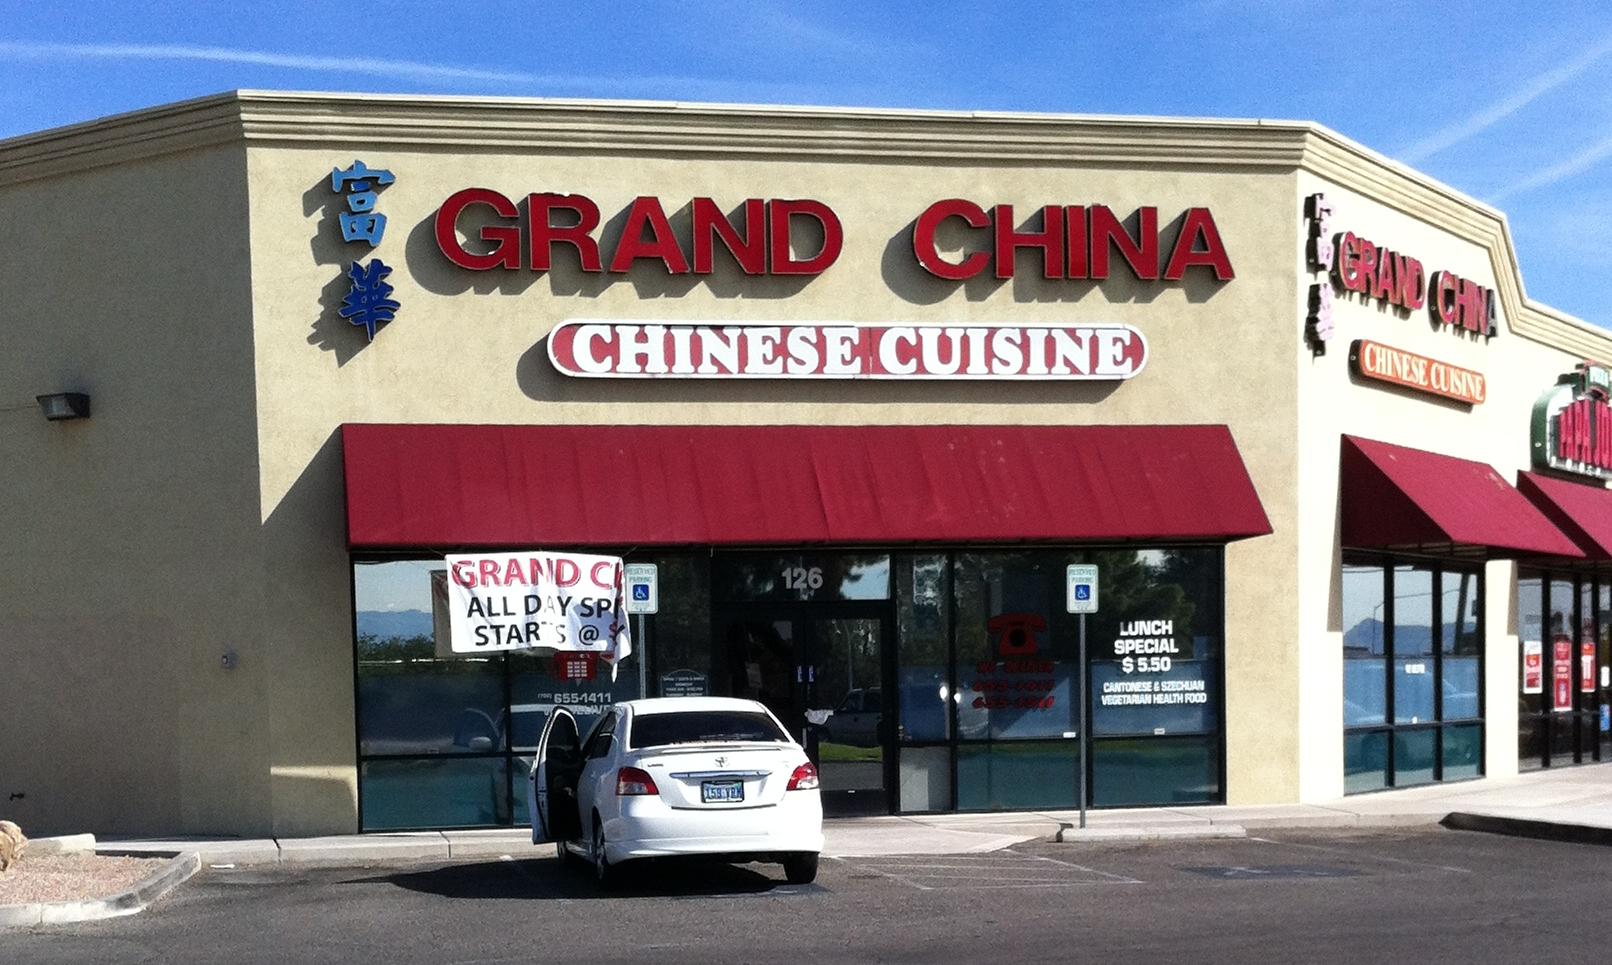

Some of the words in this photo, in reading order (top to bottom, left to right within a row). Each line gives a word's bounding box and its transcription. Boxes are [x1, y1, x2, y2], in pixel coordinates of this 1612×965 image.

[434, 187, 844, 275] GRAND
[913, 198, 1236, 281] CHINA
[1337, 231, 1426, 311] GRAND
[1437, 270, 1499, 338] CHINA
[571, 324, 862, 375] CHINESE
[878, 327, 1134, 376] CUISINE
[1363, 342, 1429, 388] CHINESE
[1430, 361, 1485, 402] CUISINE
[452, 557, 582, 589] GRAND
[781, 566, 824, 590] 126
[467, 596, 516, 618] ALL
[524, 594, 573, 617] DAY
[475, 621, 566, 647] STARS
[578, 624, 600, 646] @
[1119, 620, 1173, 636] LUNCH
[1114, 638, 1180, 655] SPECIAL
[1137, 656, 1172, 672] 5.50
[554, 692, 612, 704] 655-1411
[1103, 681, 1153, 693] CANTONESE
[1161, 680, 1205, 692] SZECHUAN
[1101, 694, 1152, 706] VEGETARIAN
[1153, 693, 1184, 704] HEALTH
[1184, 692, 1207, 703] FOOD
